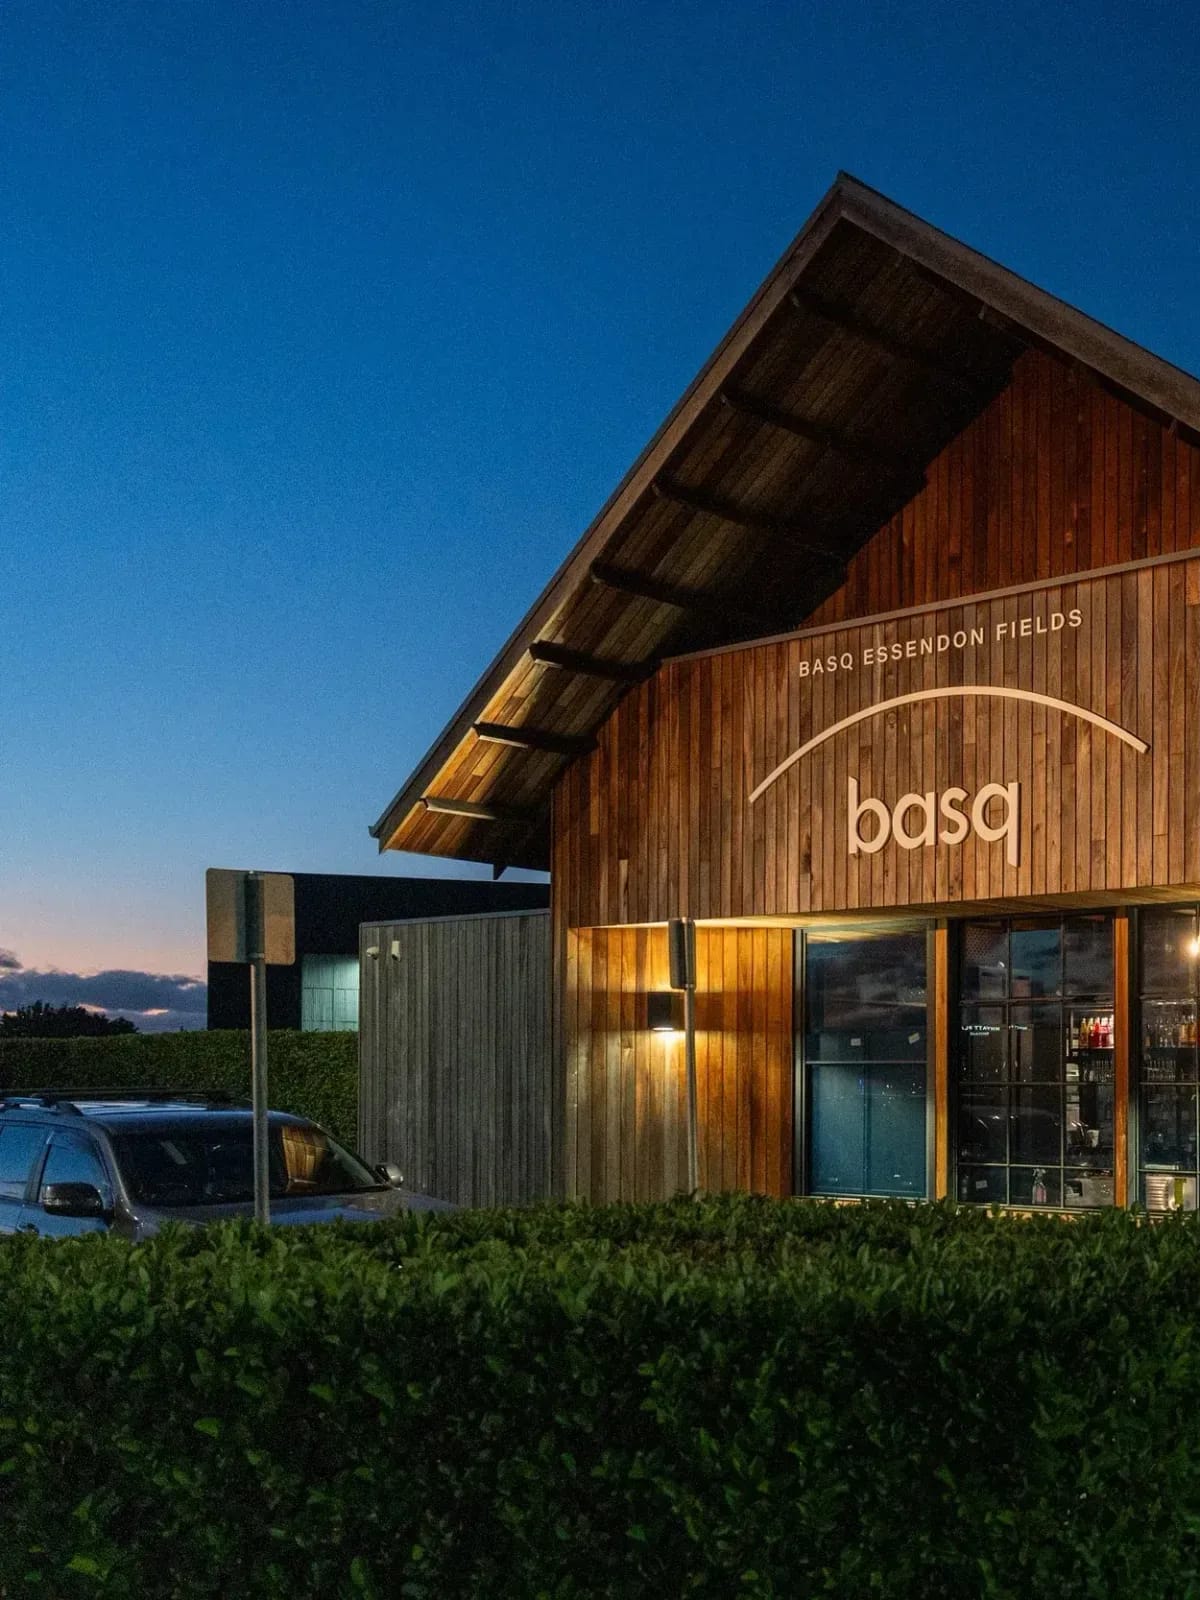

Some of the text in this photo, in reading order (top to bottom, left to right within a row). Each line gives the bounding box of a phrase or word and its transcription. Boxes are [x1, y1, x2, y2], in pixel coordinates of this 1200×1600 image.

[799, 609, 1083, 677] BASQ ESSENDON FIELDS
[848, 775, 1021, 868] basq
